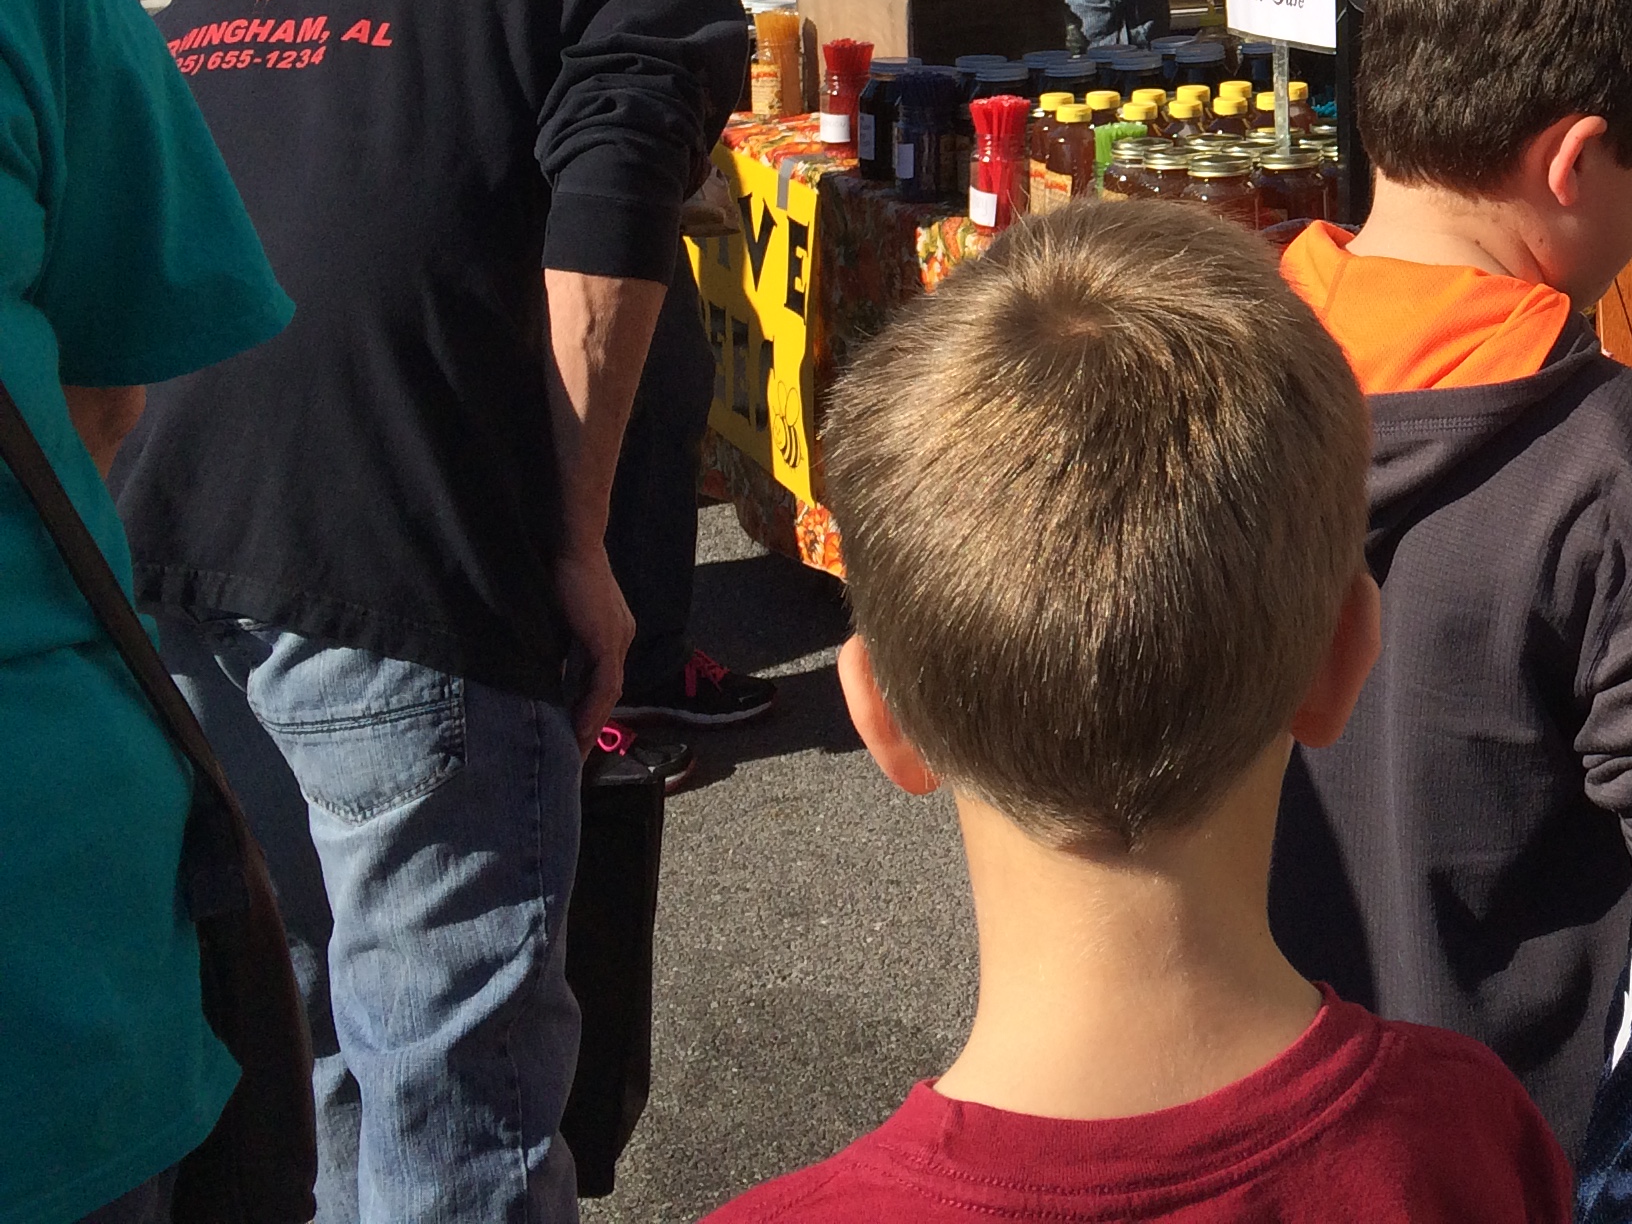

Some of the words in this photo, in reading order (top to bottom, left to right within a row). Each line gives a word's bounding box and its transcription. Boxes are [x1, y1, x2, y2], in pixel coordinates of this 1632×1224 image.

[167, 15, 332, 59] RMINGHAM,
[341, 17, 393, 47] AL
[206, 45, 327, 71] 655-1234
